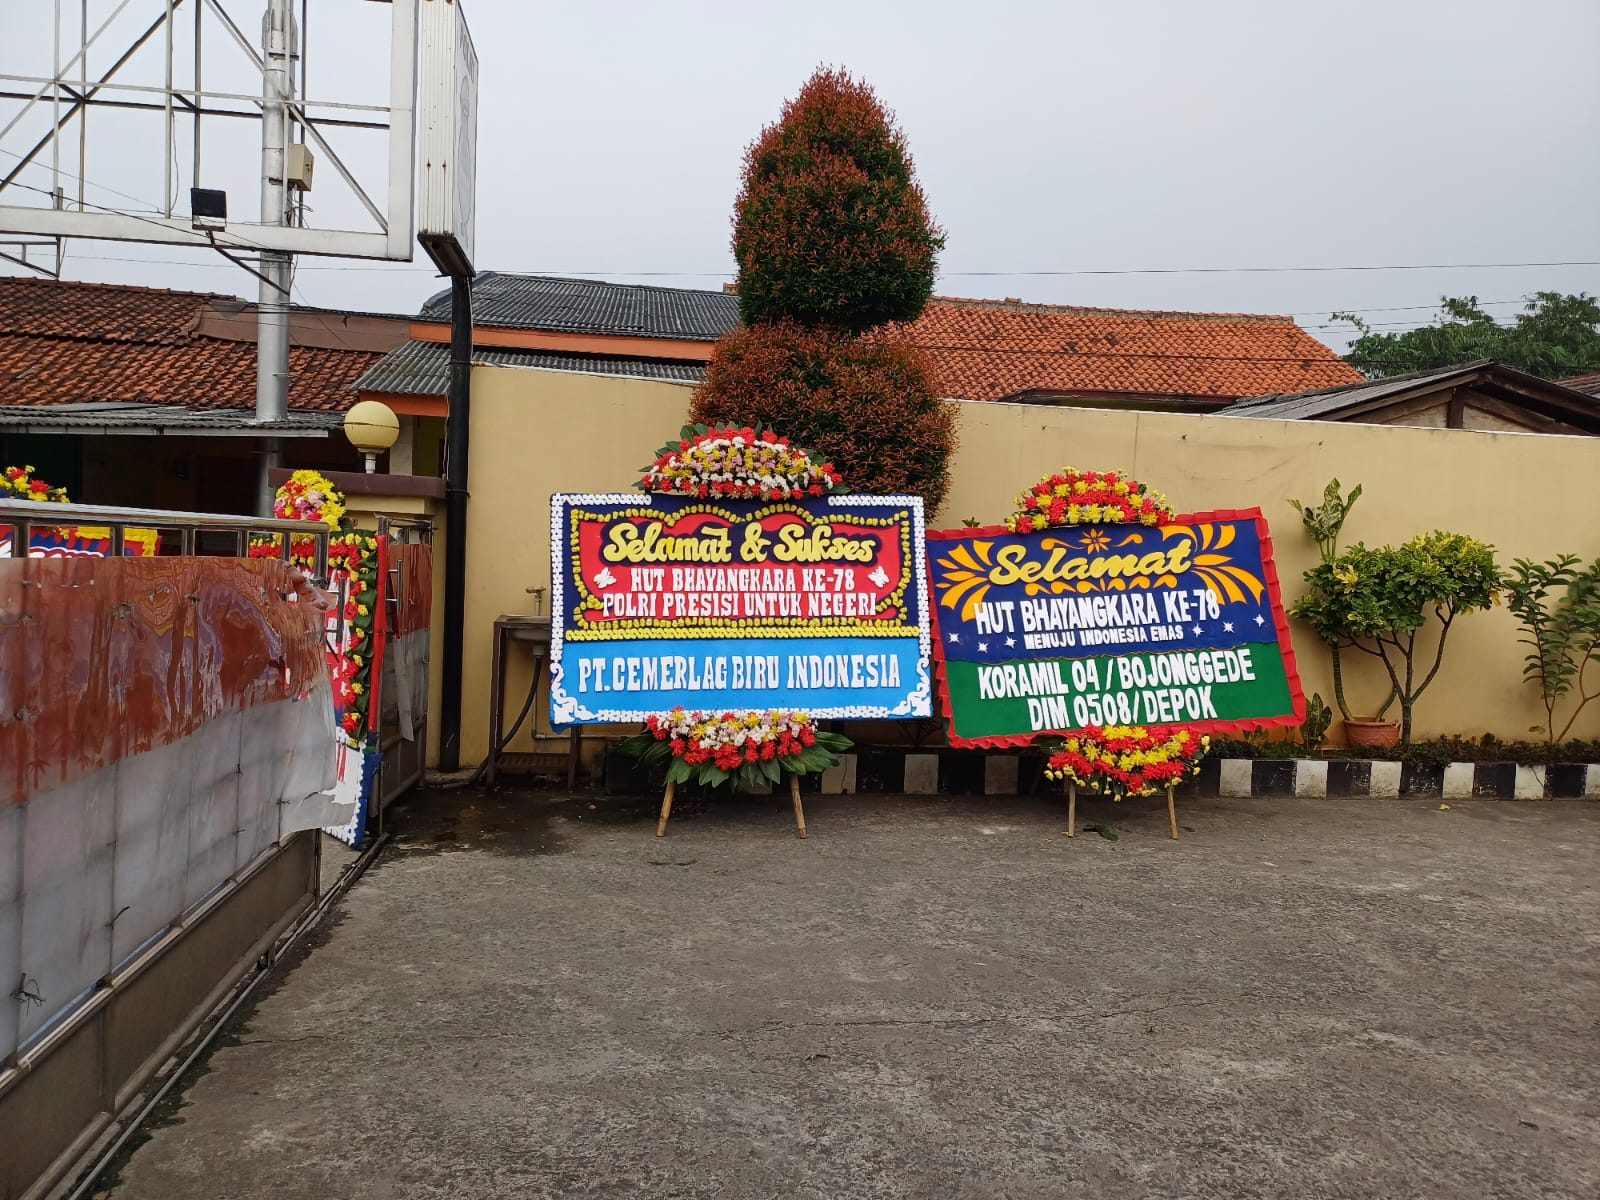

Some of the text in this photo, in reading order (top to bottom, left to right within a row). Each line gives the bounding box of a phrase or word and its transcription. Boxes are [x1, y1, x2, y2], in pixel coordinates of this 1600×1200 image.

[603, 522, 877, 562] Selamat & Sukses
[631, 568, 855, 592] HUT BHAYANGKARA KE-78
[988, 538, 1192, 586] Selamat
[602, 592, 876, 618] POLRI PRESISI UNTUK NEGERI
[973, 589, 1220, 635] HUT BHAYANGKARA KE-78
[1023, 625, 1184, 650] MENUJU INDONESIA EMAS
[732, 655, 780, 690] BIRU
[787, 654, 901, 689] INDONESIA
[977, 661, 1069, 700] KORAMIL
[1071, 659, 1100, 692] 04
[1027, 696, 1070, 731] DIM
